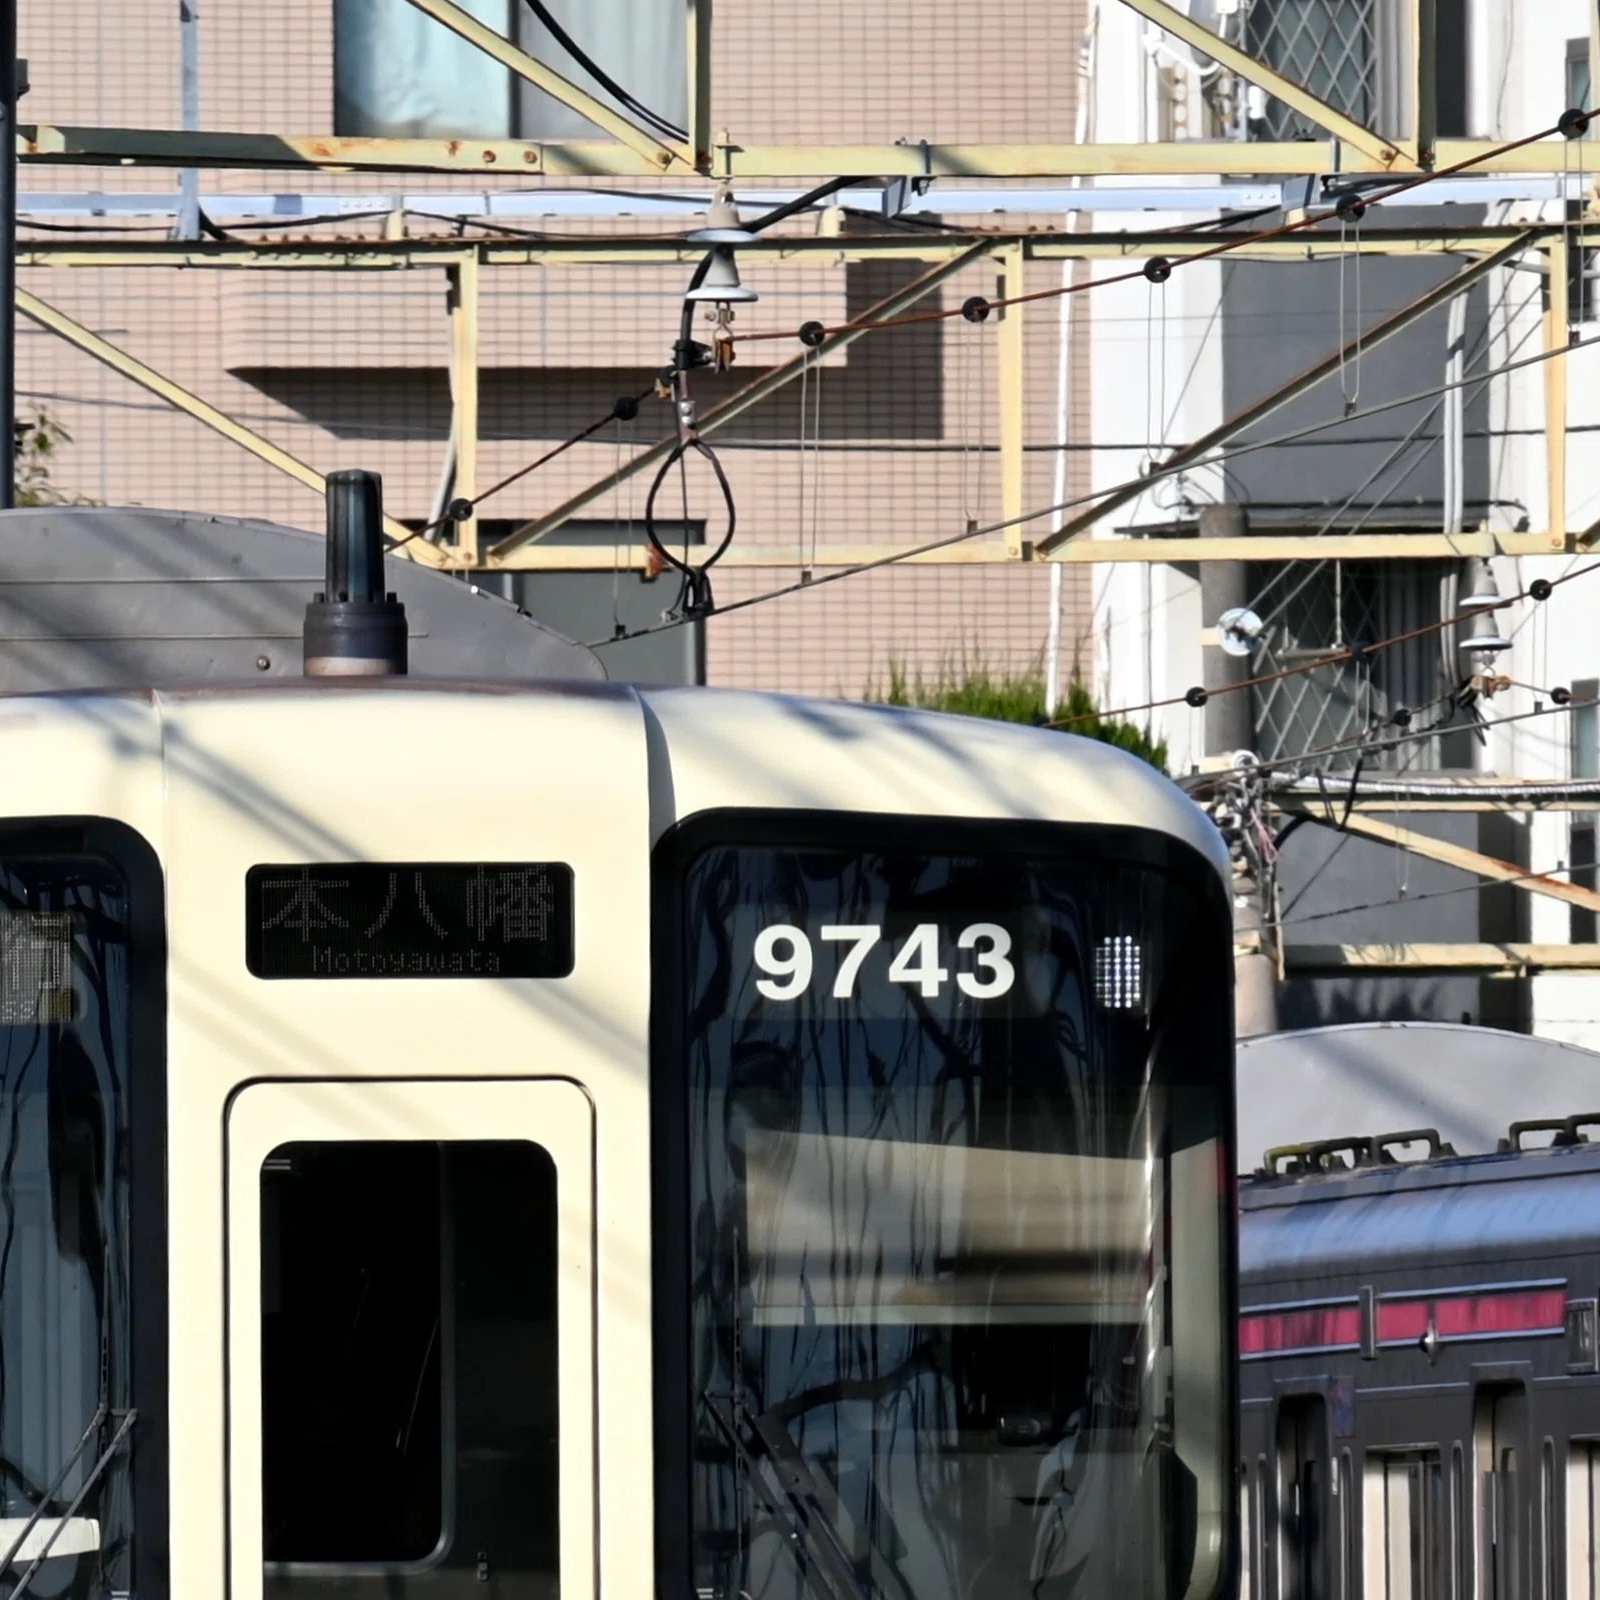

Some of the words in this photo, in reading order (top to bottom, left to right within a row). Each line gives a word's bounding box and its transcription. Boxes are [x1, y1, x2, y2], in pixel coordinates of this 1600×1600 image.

[262, 865, 554, 942] 本八幡
[313, 945, 500, 974] Motoyawata
[754, 922, 1016, 1001] 9743
